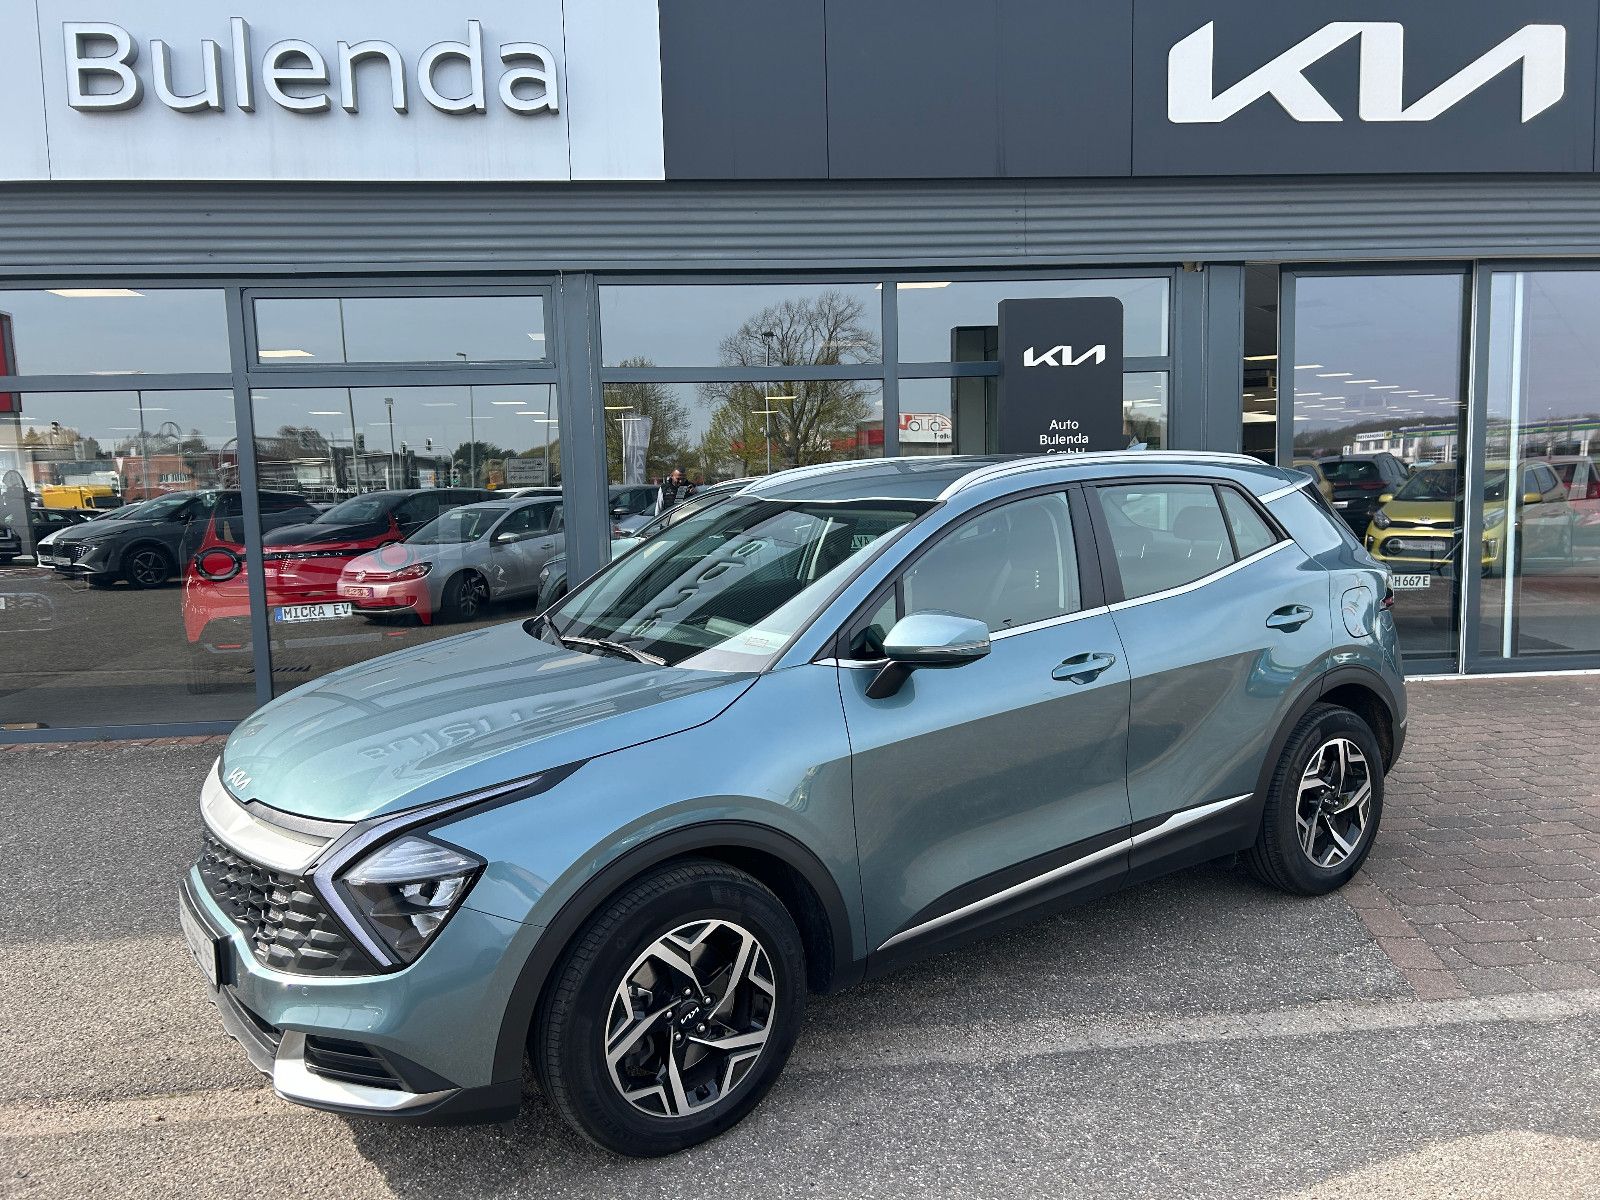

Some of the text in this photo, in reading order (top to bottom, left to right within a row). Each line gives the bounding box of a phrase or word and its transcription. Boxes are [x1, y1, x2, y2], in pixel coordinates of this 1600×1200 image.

[62, 17, 560, 116] Bulenda
[1167, 21, 1566, 123] KIA
[1023, 345, 1106, 367] KIA
[1049, 419, 1079, 430] Auto
[1039, 432, 1089, 445] Bulenda
[283, 605, 326, 619] MICRA
[333, 603, 350, 616] EV
